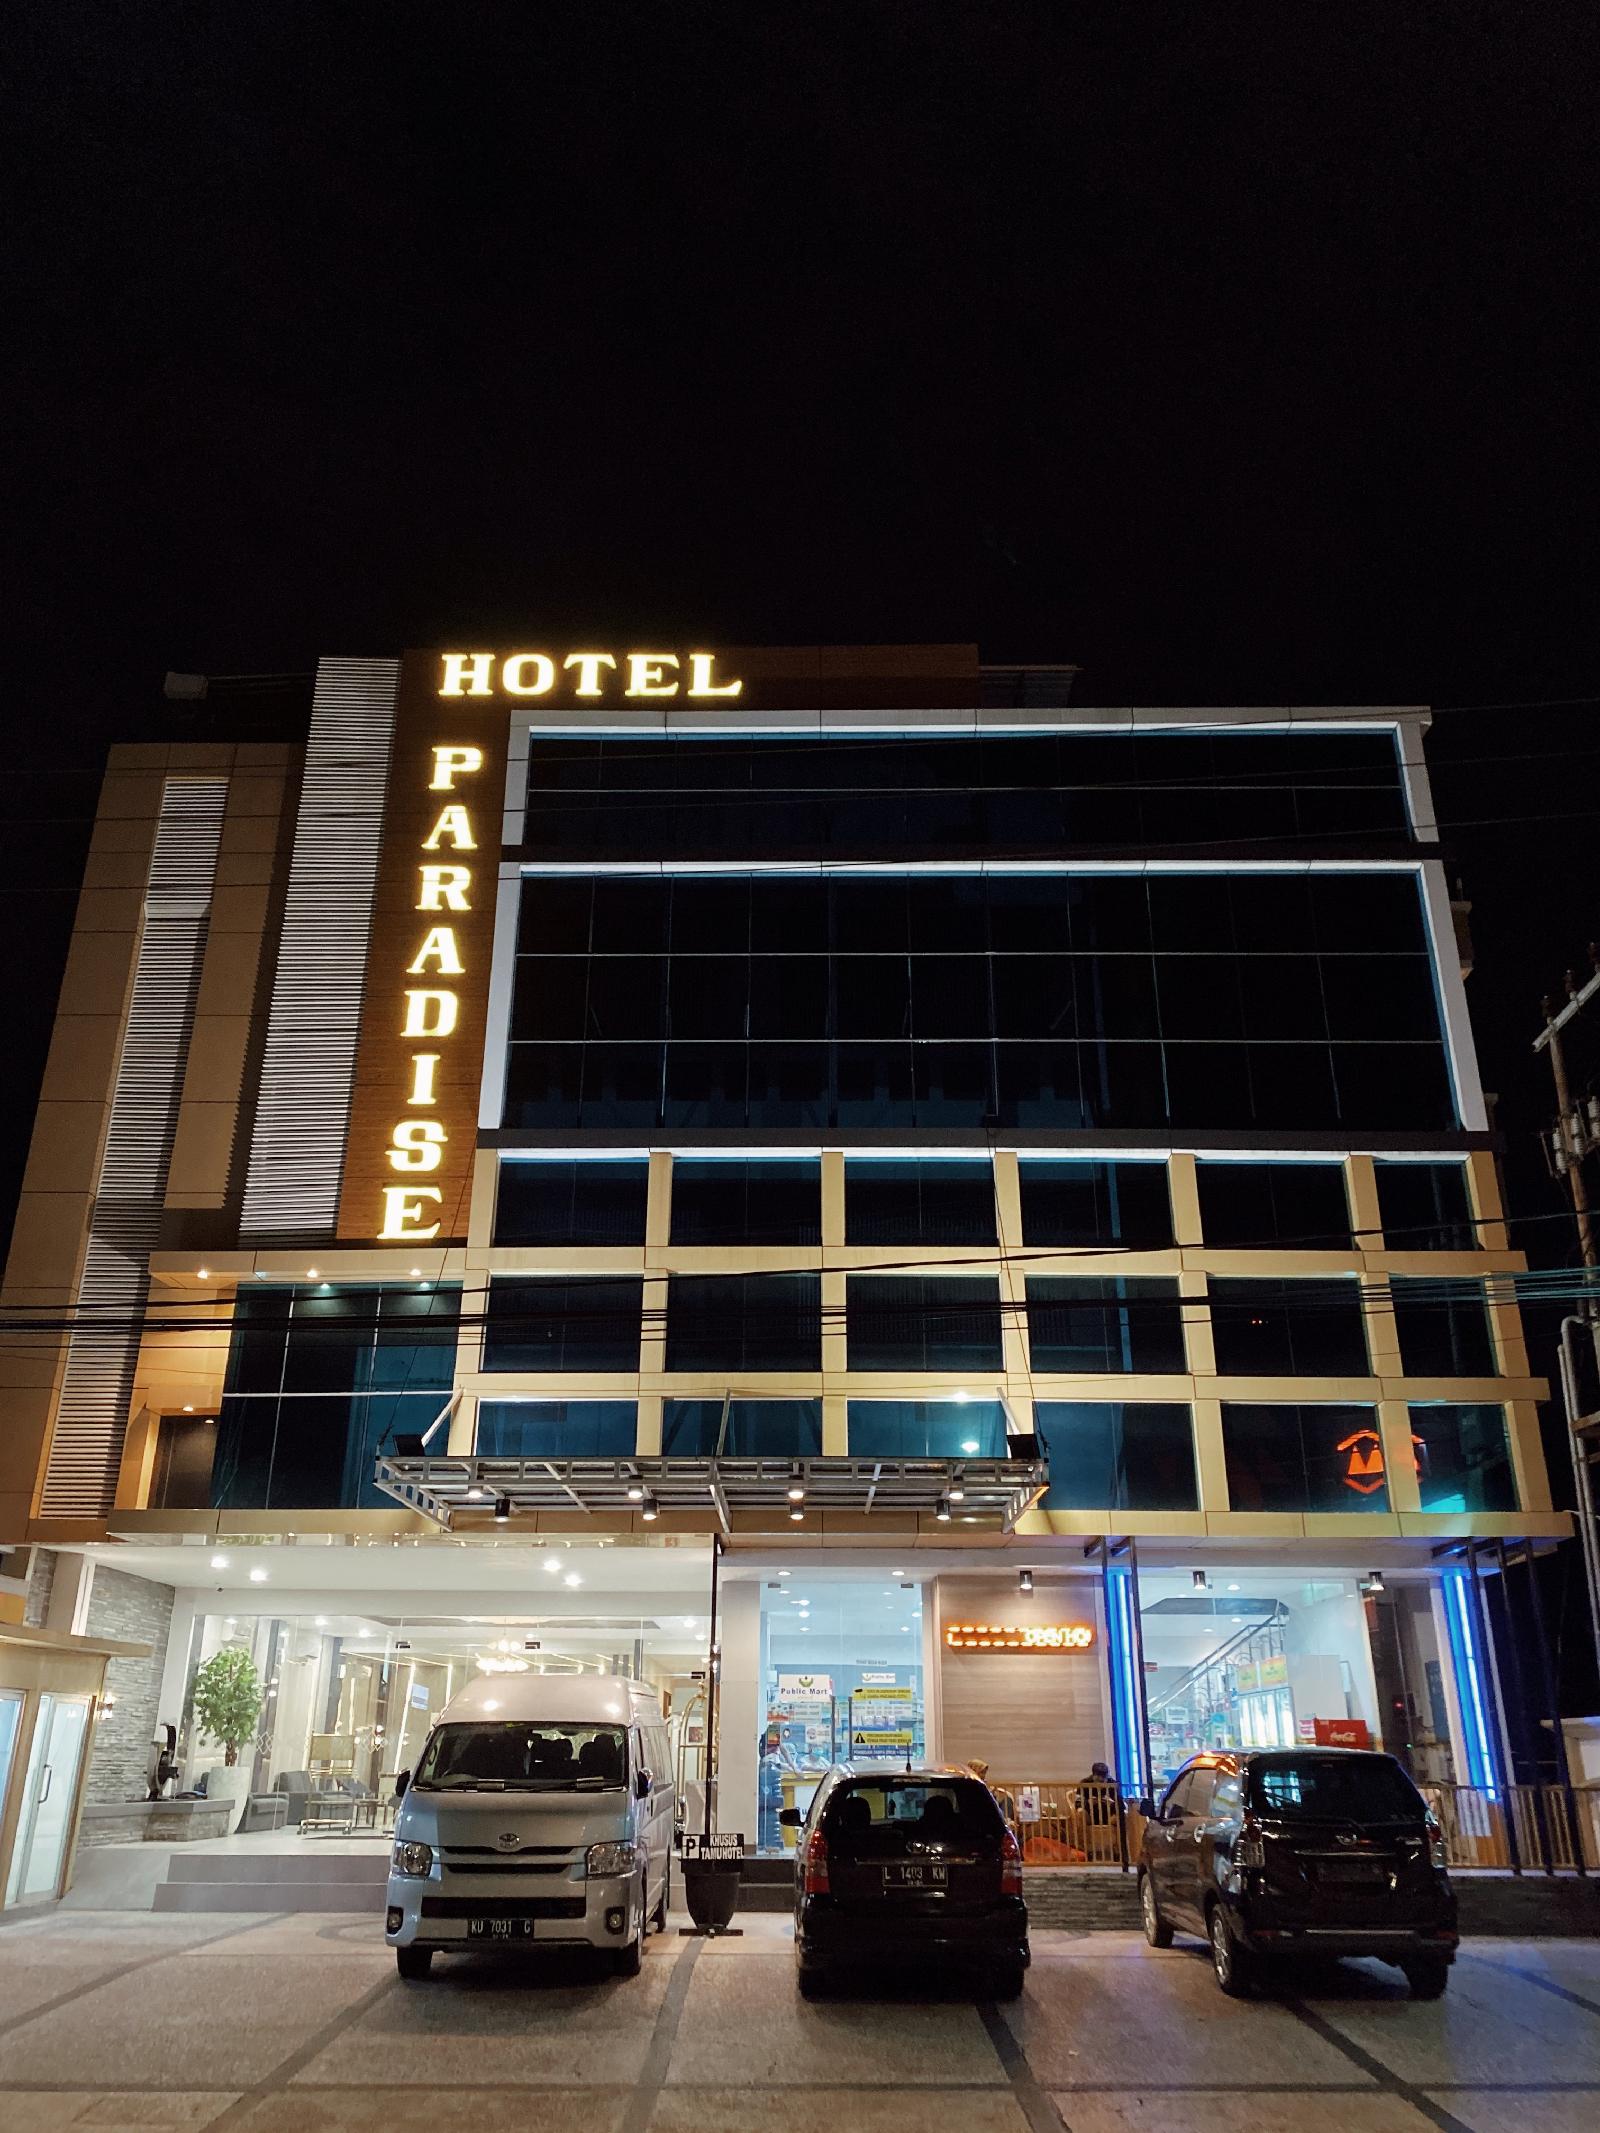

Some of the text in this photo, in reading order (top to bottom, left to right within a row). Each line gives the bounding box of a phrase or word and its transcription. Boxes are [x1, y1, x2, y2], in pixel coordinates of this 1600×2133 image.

[438, 652, 744, 698] HOTEL
[376, 745, 484, 1241] PARADISE
[710, 1834, 738, 1847] KHUSUS
[884, 1866, 891, 1880] L
[471, 1919, 484, 1934] KU
[489, 1919, 512, 1934] 7031
